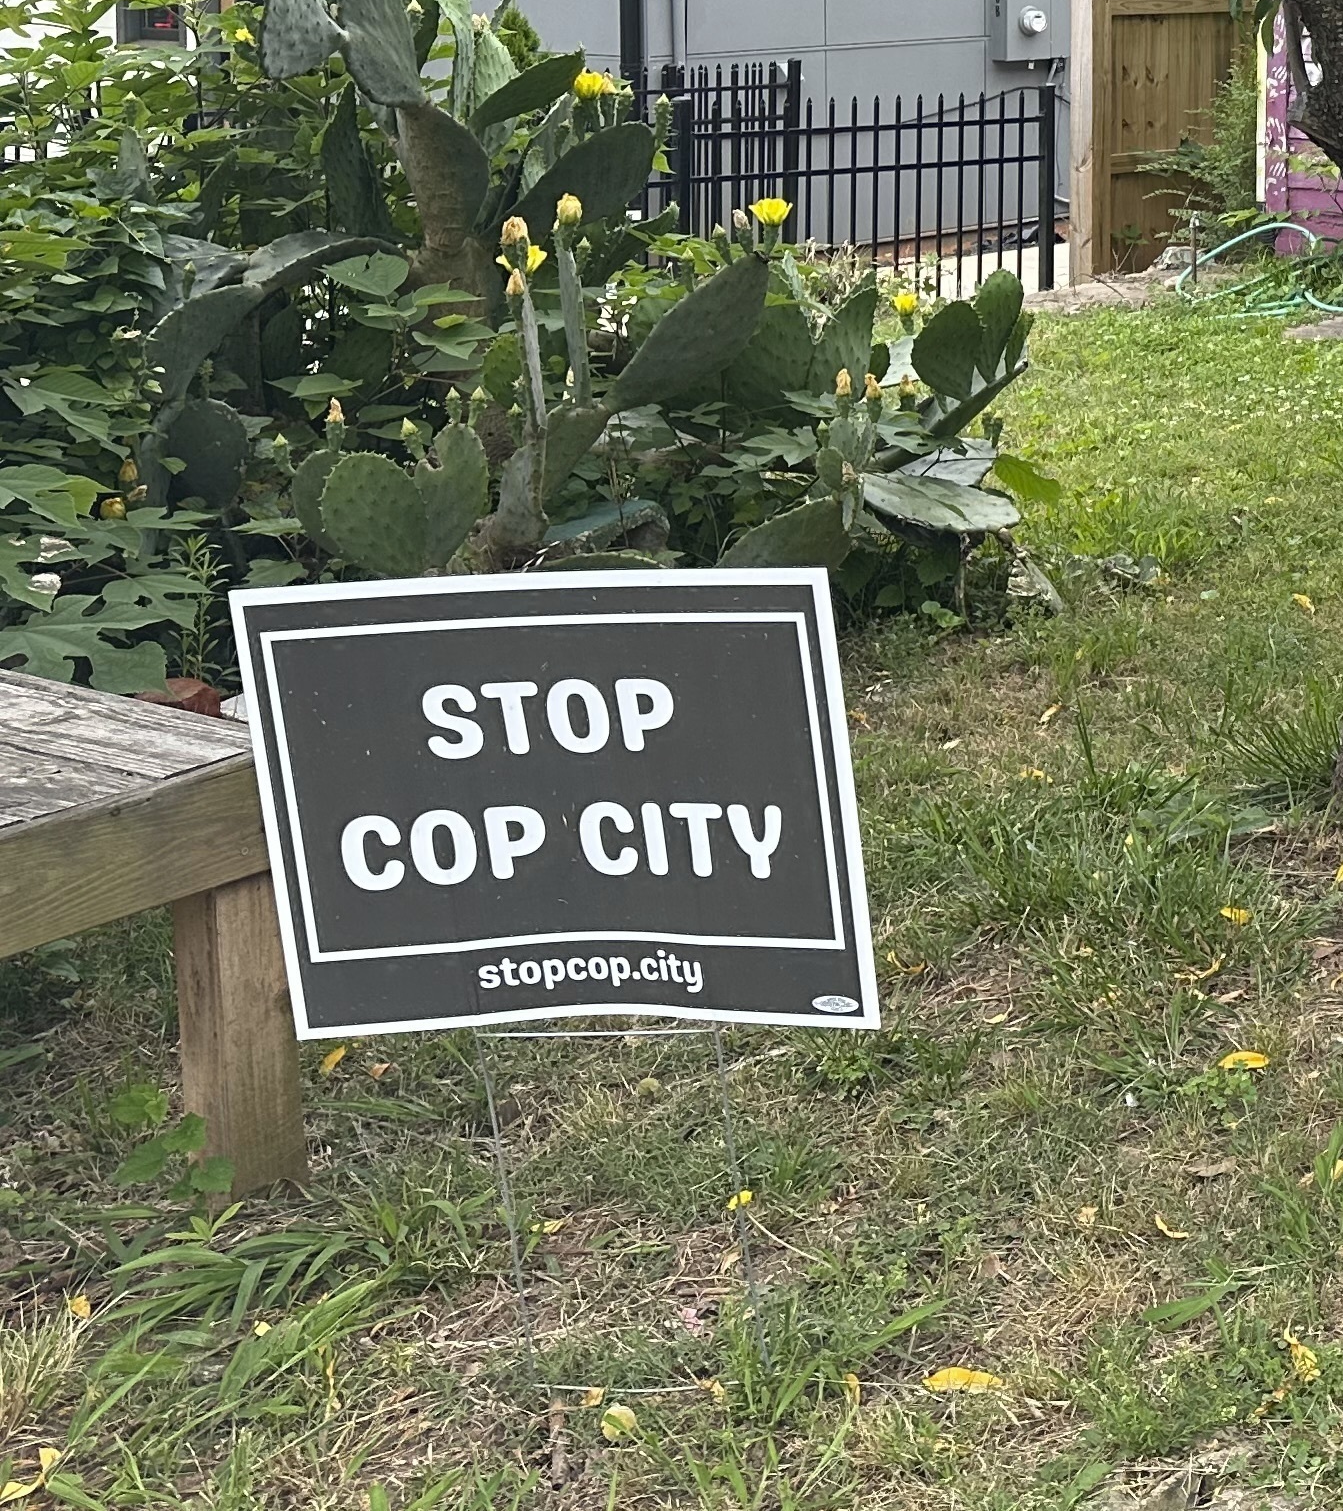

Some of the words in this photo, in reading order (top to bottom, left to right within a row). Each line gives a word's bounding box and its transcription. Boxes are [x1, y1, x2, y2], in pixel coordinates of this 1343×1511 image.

[421, 676, 675, 760] STOP
[340, 804, 547, 892] COP
[578, 801, 783, 880] CITY
[478, 949, 704, 994] stopcop.city
